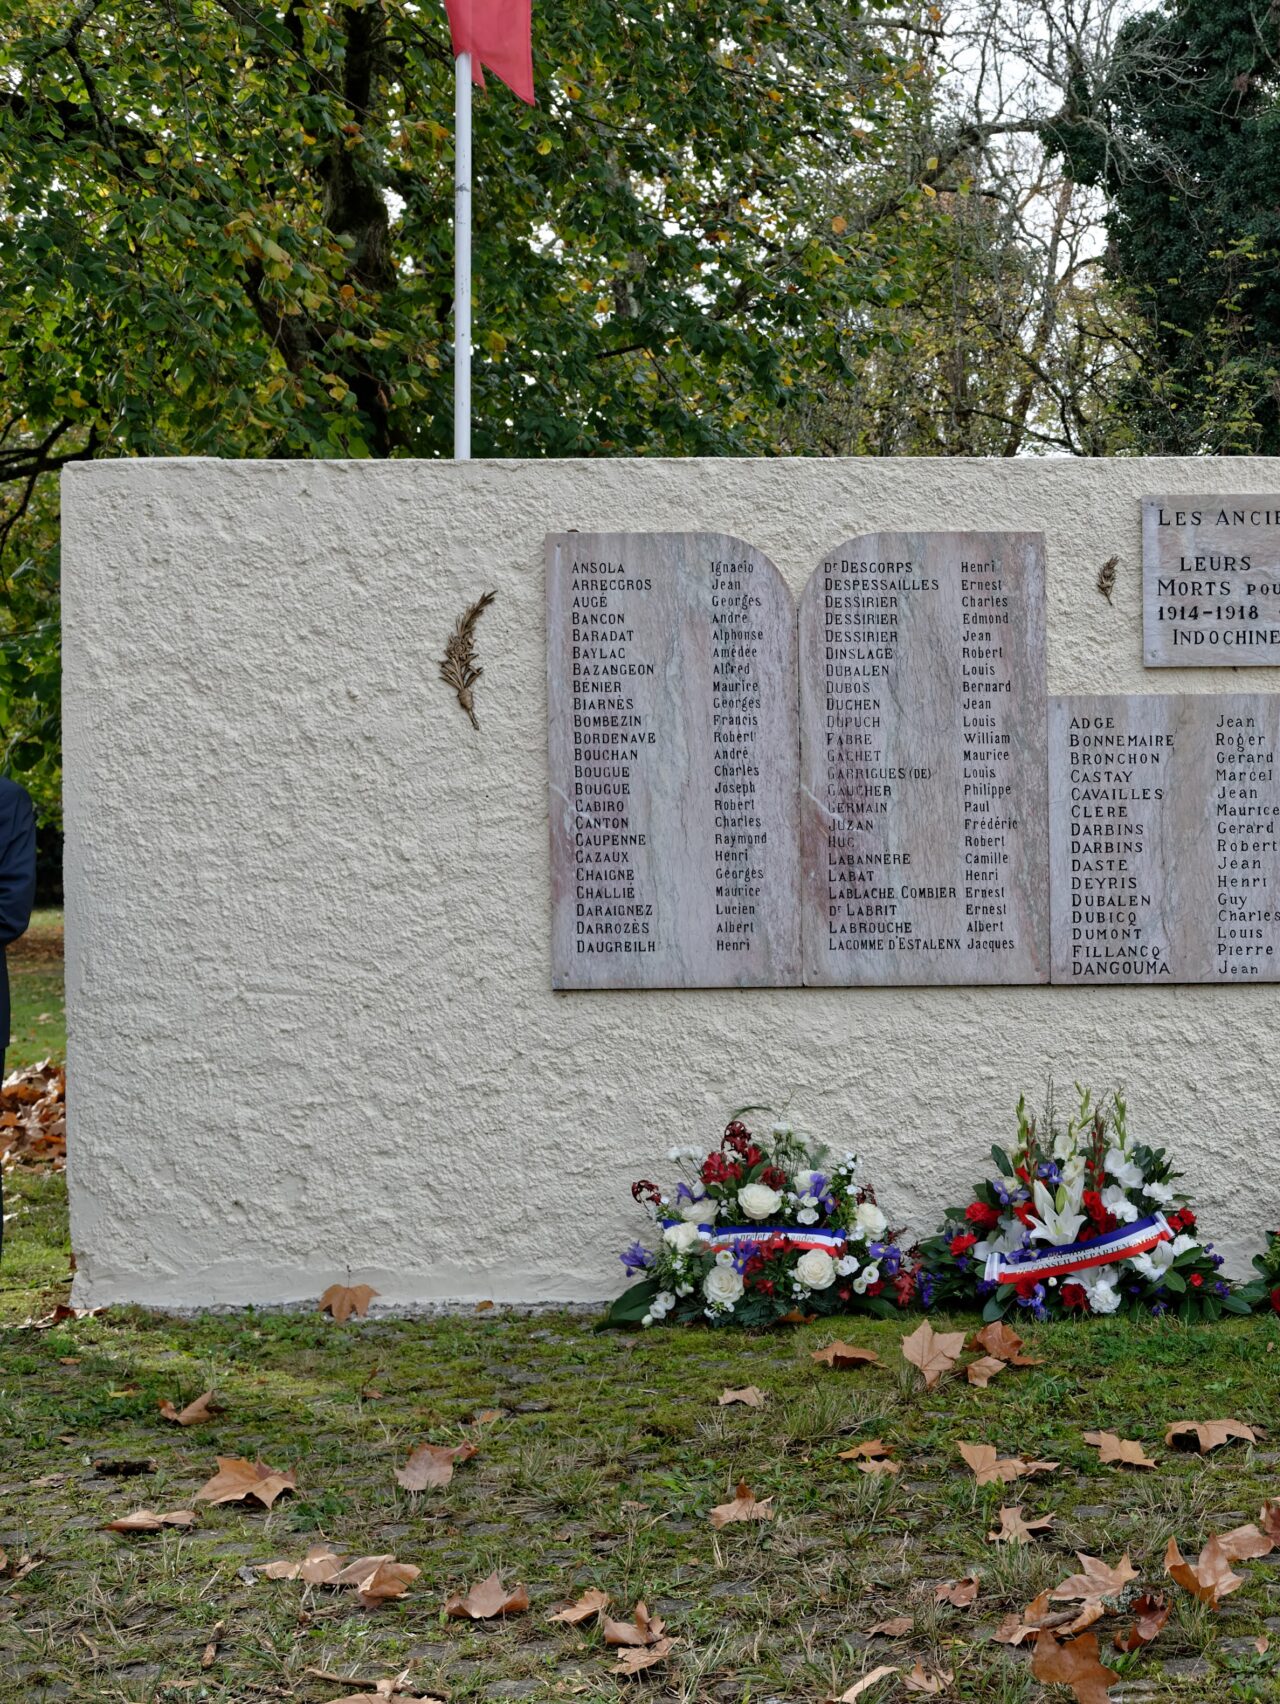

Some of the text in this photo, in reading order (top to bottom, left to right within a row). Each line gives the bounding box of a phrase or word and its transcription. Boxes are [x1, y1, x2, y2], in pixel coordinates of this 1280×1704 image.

[1158, 509, 1201, 526] LES
[572, 561, 753, 576] ANSOLA Ignacio
[1180, 557, 1251, 572] LEURS
[572, 579, 741, 591] ARRECGROS Jean
[825, 579, 1002, 590] DESPESSAILLES Ernest
[1158, 580, 1230, 596] MORTS
[825, 596, 1008, 608] DESSIRIER Charles
[825, 613, 1009, 625] DESSIRIER Edmond
[1158, 605, 1258, 620] 1914-1918
[573, 630, 763, 644] BARADAT Alphonse
[1173, 630, 1280, 645] INDOCHINE
[826, 648, 1003, 660] DINSLAGE Robert
[573, 664, 750, 675] BAZANGEON Alfred
[826, 681, 1011, 693] DUBOS Bernard
[826, 699, 991, 710] DUCHEN Jean
[574, 715, 758, 727] BOMBEZIN Francis
[1070, 715, 1255, 729] ADGE Jean
[574, 732, 756, 744] BORDENAVE Robert
[827, 732, 1010, 745] FABRE William
[1070, 733, 1266, 752] BONNEMAIRE Roger
[1071, 770, 1272, 783] CASTAY Marcel
[575, 783, 755, 795] BOUGUE Joseph
[1072, 787, 1257, 800] CAVAILLES Jean
[575, 817, 761, 829] CANTON Charles
[576, 833, 767, 847] CAUPENNE Raymond
[1072, 840, 1278, 853] DARBINS Robert
[576, 850, 748, 863] CAZAUX Henri
[1072, 857, 1261, 871] DASTE Jean
[828, 870, 998, 882] LABAT Henri
[829, 886, 1004, 899] LABLACHE COMBIER Ernest
[1072, 894, 1247, 909] DUBALEN Guy
[577, 904, 755, 916] DARAIGNEZ Lucien
[1073, 910, 1280, 926] DUBICQ Charles
[829, 921, 1003, 933] LABROUCHE Albert
[1073, 927, 1263, 940] DUMONT Louis
[577, 940, 750, 952] DAUGREILH Henri
[1073, 944, 1273, 960] FILLANCQ Pierre
[1073, 961, 1258, 975] DANGOUMA Jean
